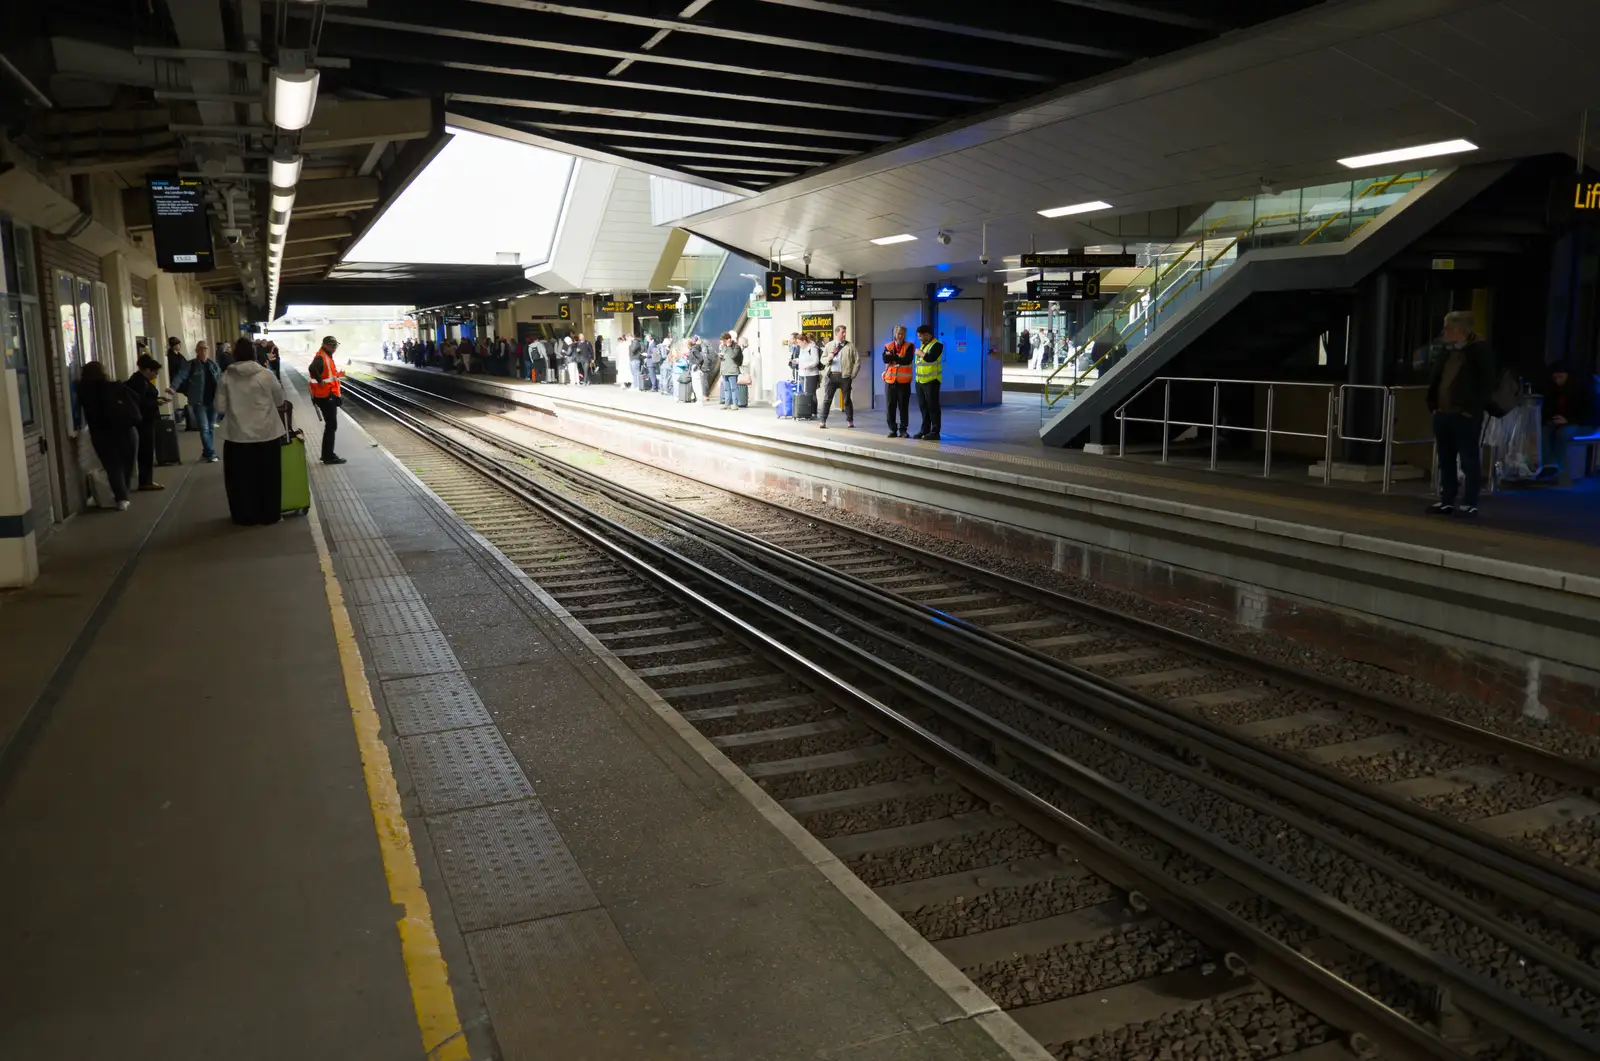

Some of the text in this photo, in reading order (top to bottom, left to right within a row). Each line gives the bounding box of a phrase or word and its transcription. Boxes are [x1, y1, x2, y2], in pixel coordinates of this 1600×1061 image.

[1574, 182, 1600, 209] Lif
[771, 276, 782, 298] 5
[1086, 277, 1097, 296] 6
[208, 307, 216, 316] 4
[560, 305, 569, 318] 5
[817, 316, 832, 329] Airport
